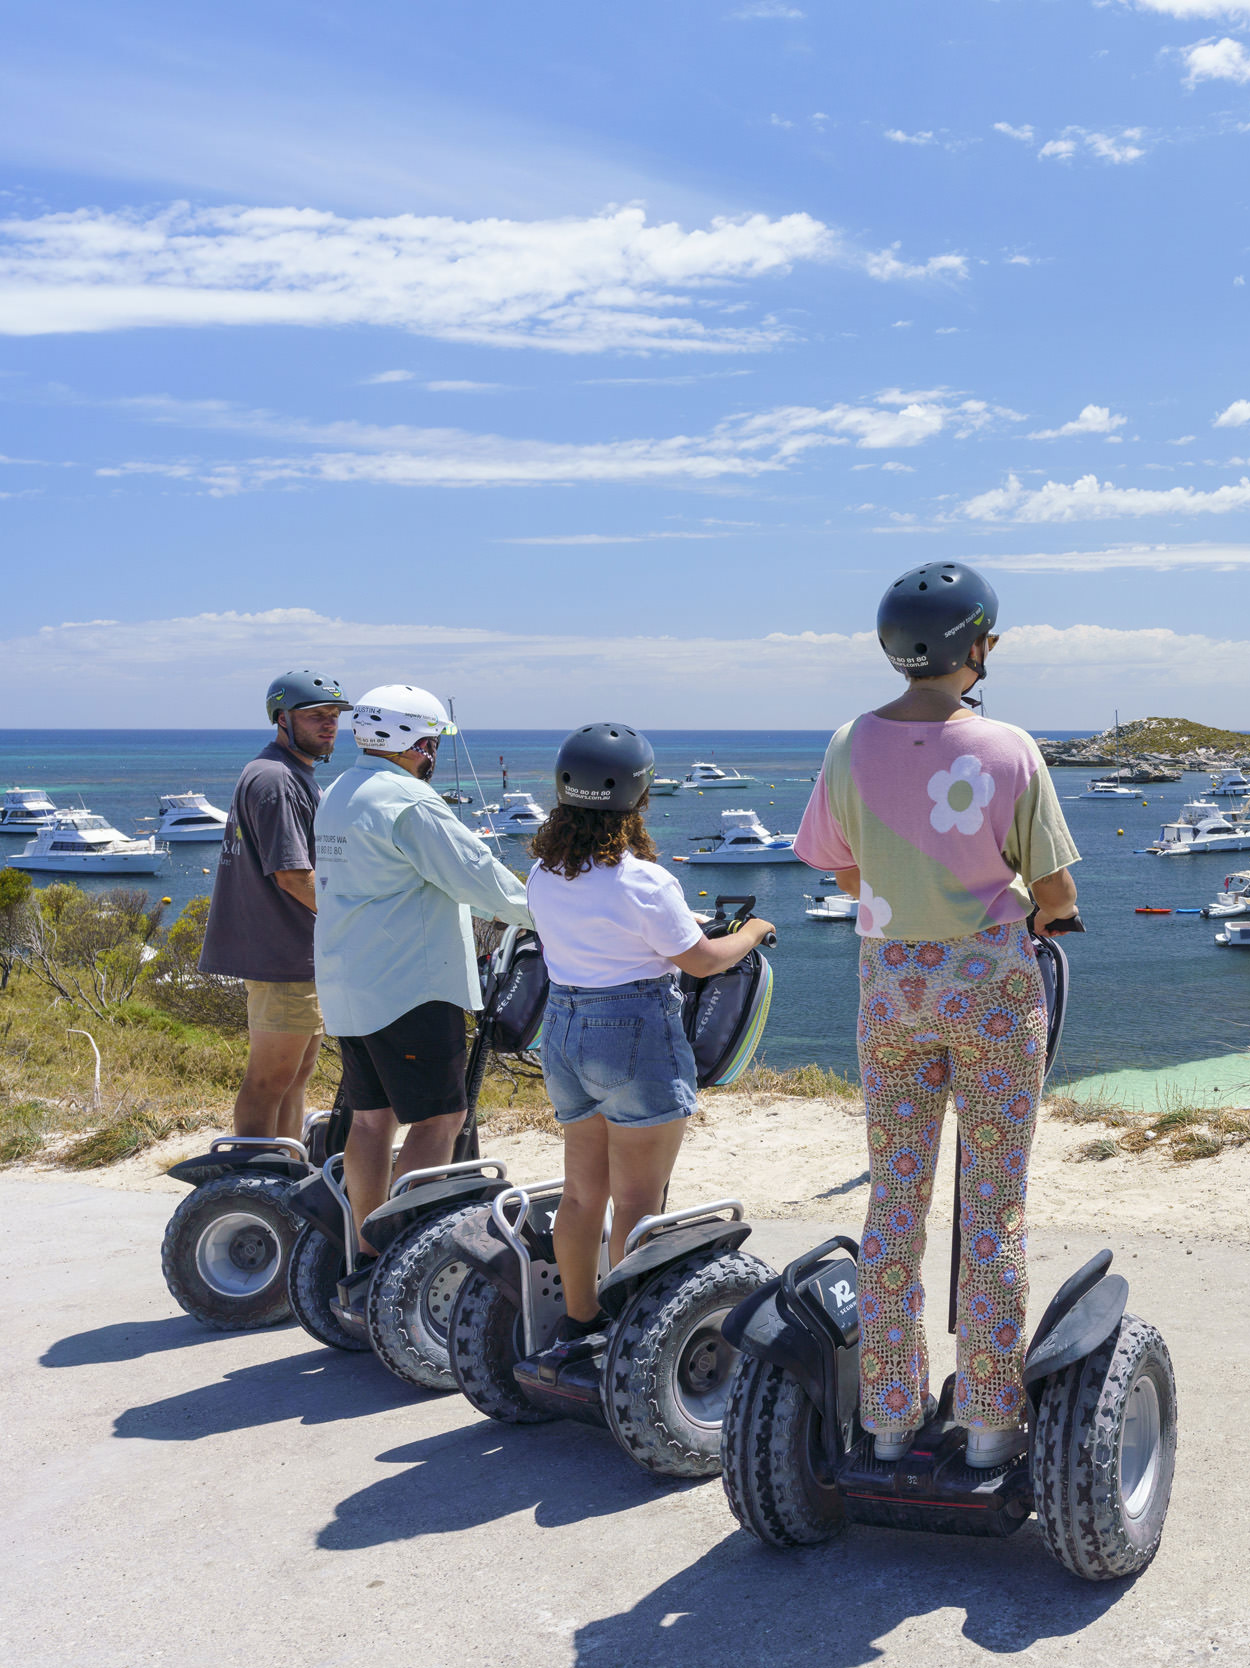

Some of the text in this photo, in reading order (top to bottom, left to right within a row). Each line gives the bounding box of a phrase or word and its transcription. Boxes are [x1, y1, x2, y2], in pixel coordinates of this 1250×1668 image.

[944, 621, 965, 638] segway
[916, 655, 927, 663] 80
[565, 785, 579, 793] 1300
[564, 790, 611, 800] segtours.com.au
[337, 835, 347, 843] WA
[333, 846, 343, 855] 80
[496, 969, 523, 1014] SEGWAY
[840, 1301, 857, 1315] SEGW
[907, 1475, 917, 1485] 32
